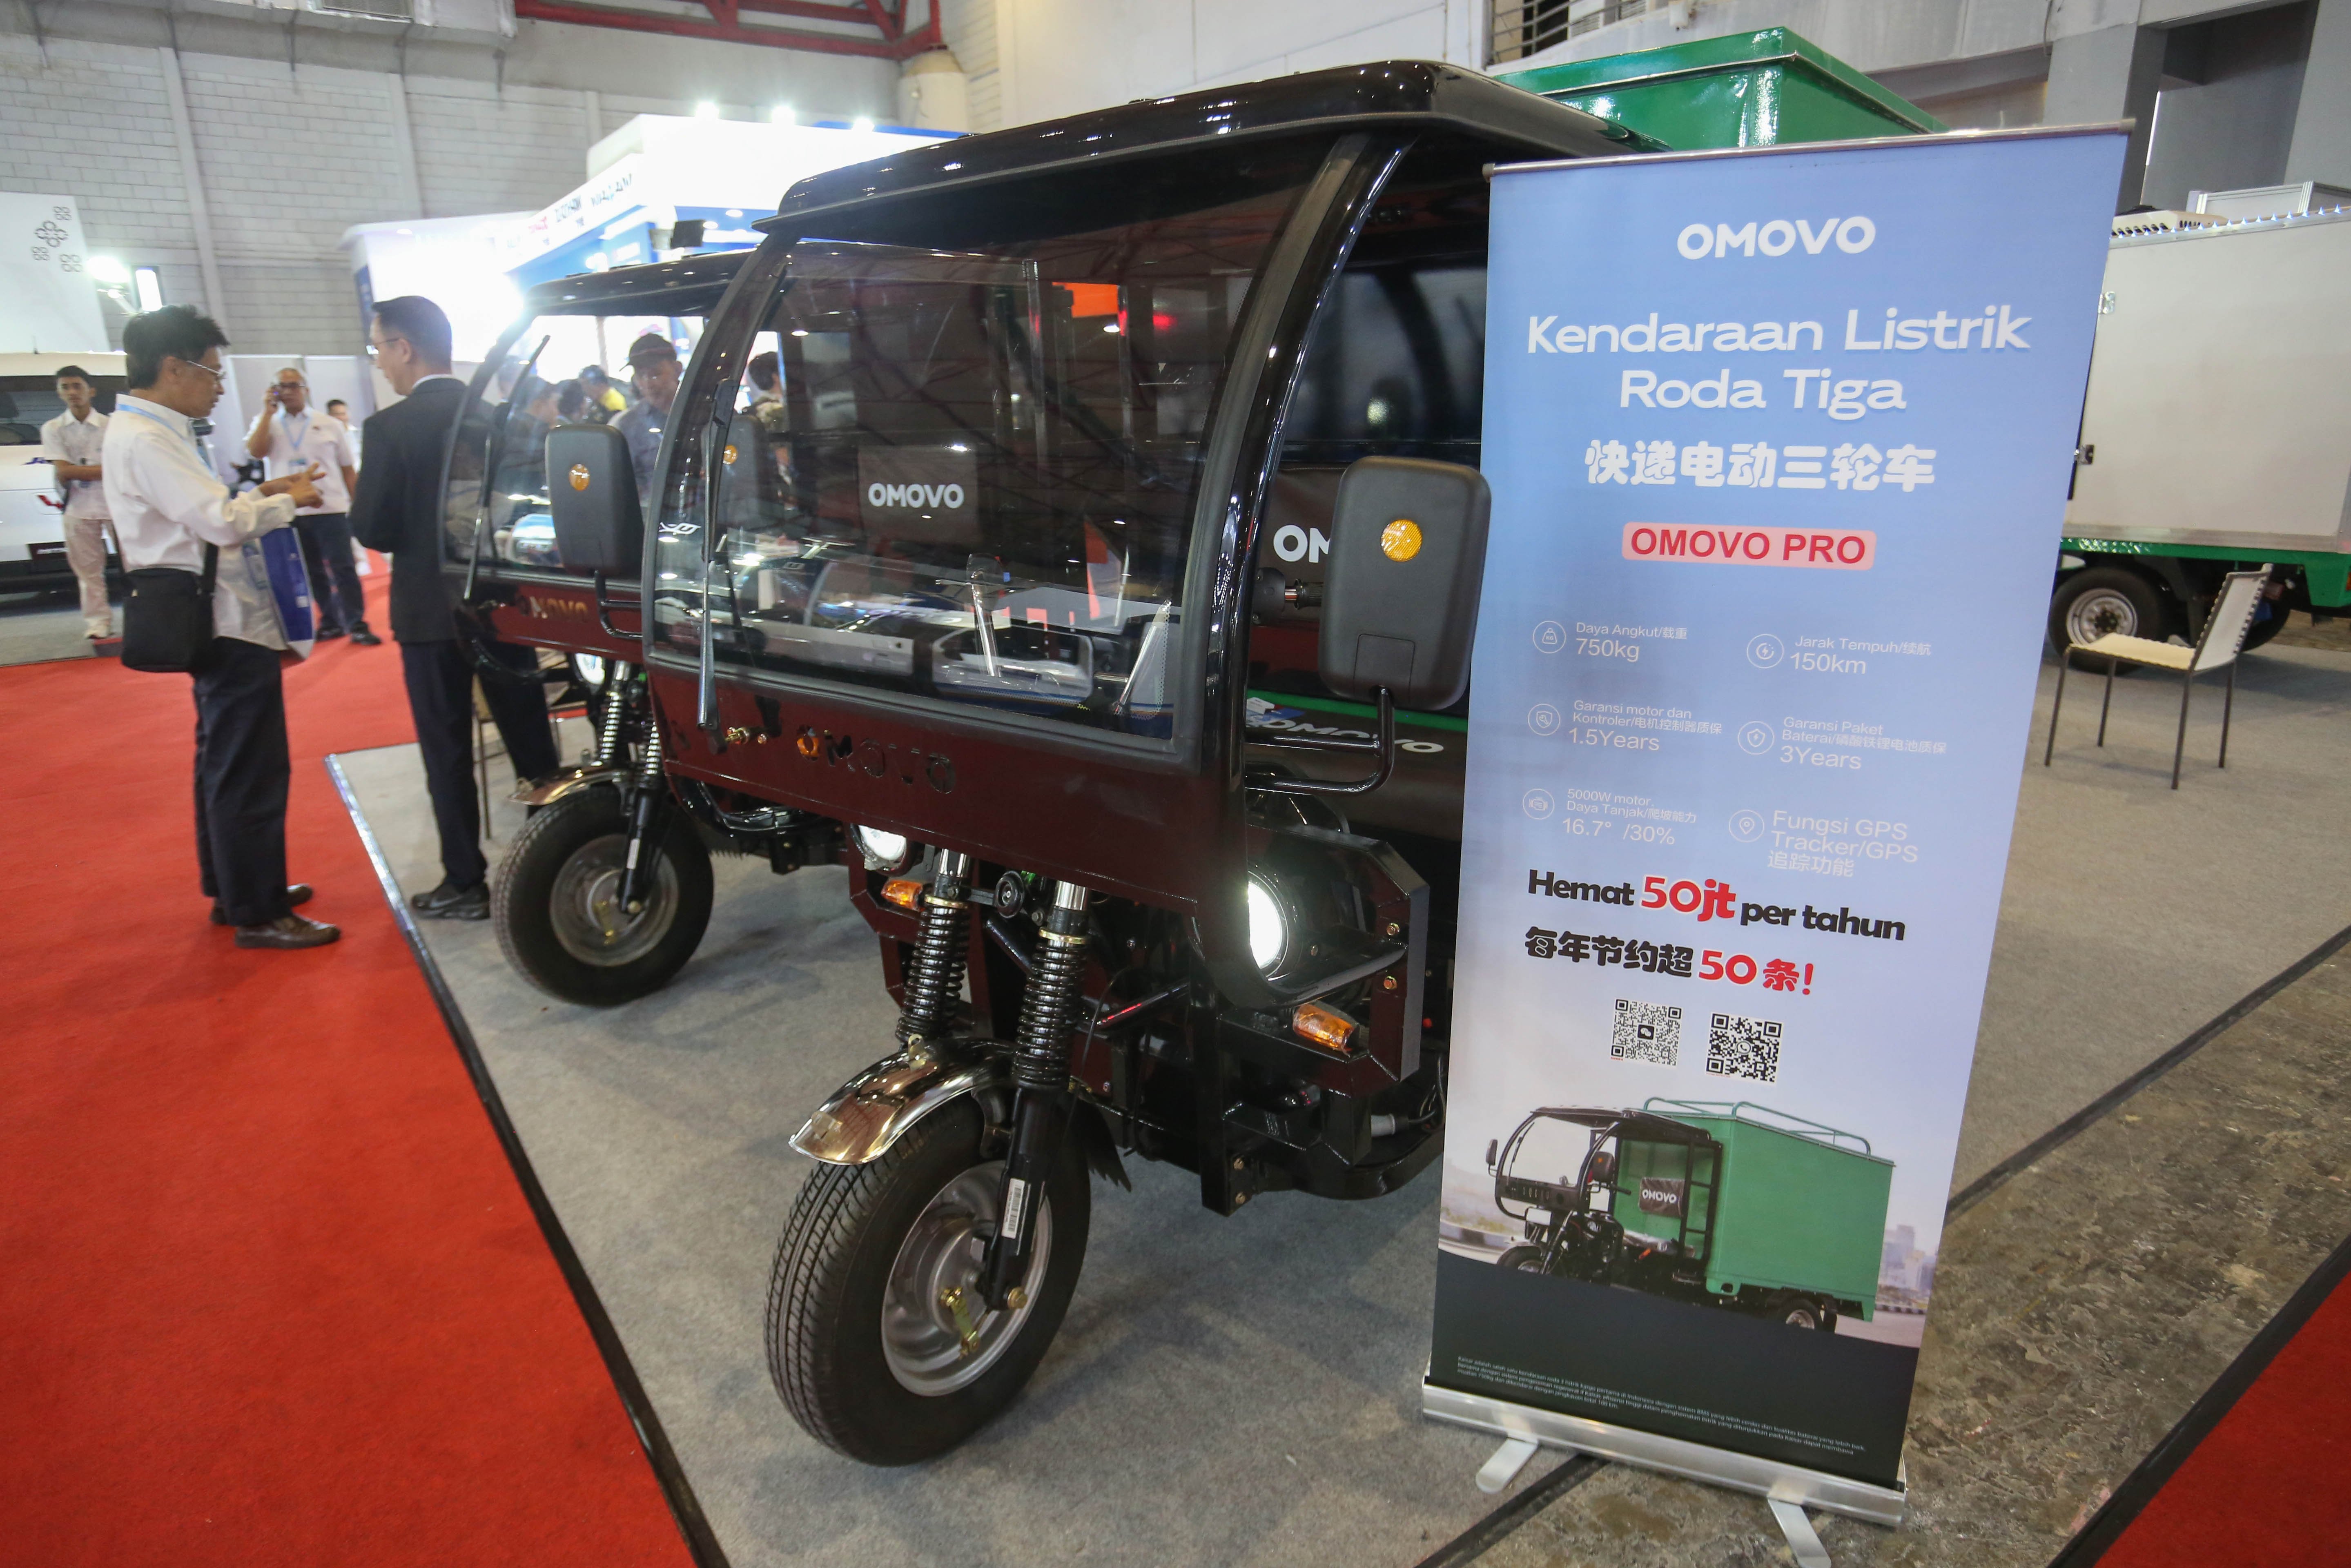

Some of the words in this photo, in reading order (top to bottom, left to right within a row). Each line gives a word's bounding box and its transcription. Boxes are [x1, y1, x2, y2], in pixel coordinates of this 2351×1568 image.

[1677, 216, 1876, 260] OMOVO
[1528, 311, 1823, 354] Kendaraan
[1844, 305, 2032, 350] Listrik
[1620, 368, 1766, 410] Roda
[1783, 368, 1907, 420] Tiga
[1584, 439, 1937, 492] 快递电动三轮车
[868, 483, 964, 509] OMOVO
[1630, 527, 1770, 561] OMOVO
[1783, 531, 1866, 564] PRO
[1576, 622, 1608, 636] Daya
[1612, 624, 1687, 640] Angkut/载重
[1576, 638, 1640, 662] 750kg
[1795, 636, 1835, 649] Jarak
[1840, 638, 1931, 656] Tempuh/续航
[1790, 652, 1866, 674] 150km
[1574, 700, 1623, 713] Garansi
[1627, 706, 1664, 716] motor
[1667, 708, 1691, 719] dan
[1573, 713, 1722, 735] Kontroler/电机控制器质保
[1783, 717, 1838, 731] Garansi
[1842, 721, 1883, 735] Paket
[1569, 727, 1660, 751] 1.5Years
[1780, 746, 1861, 769] 3Years
[1568, 789, 1611, 802] 5000W
[1567, 800, 1598, 814] Daya
[1602, 804, 1696, 823] Tanjak/爬坡能力
[1562, 817, 1611, 836] 16.7°
[1623, 824, 1675, 845] /30%
[1773, 811, 1849, 836] Fungsi
[1856, 819, 1908, 841] GPS
[1772, 831, 1918, 863] Tracker/GPS
[1767, 851, 1854, 878] 追踪功能
[1528, 869, 1635, 907] Hemat
[1641, 875, 1736, 921] 50jt
[1740, 901, 1796, 926] per
[1802, 905, 1905, 940] tahun
[1642, 1188, 1677, 1203] OMOVO
